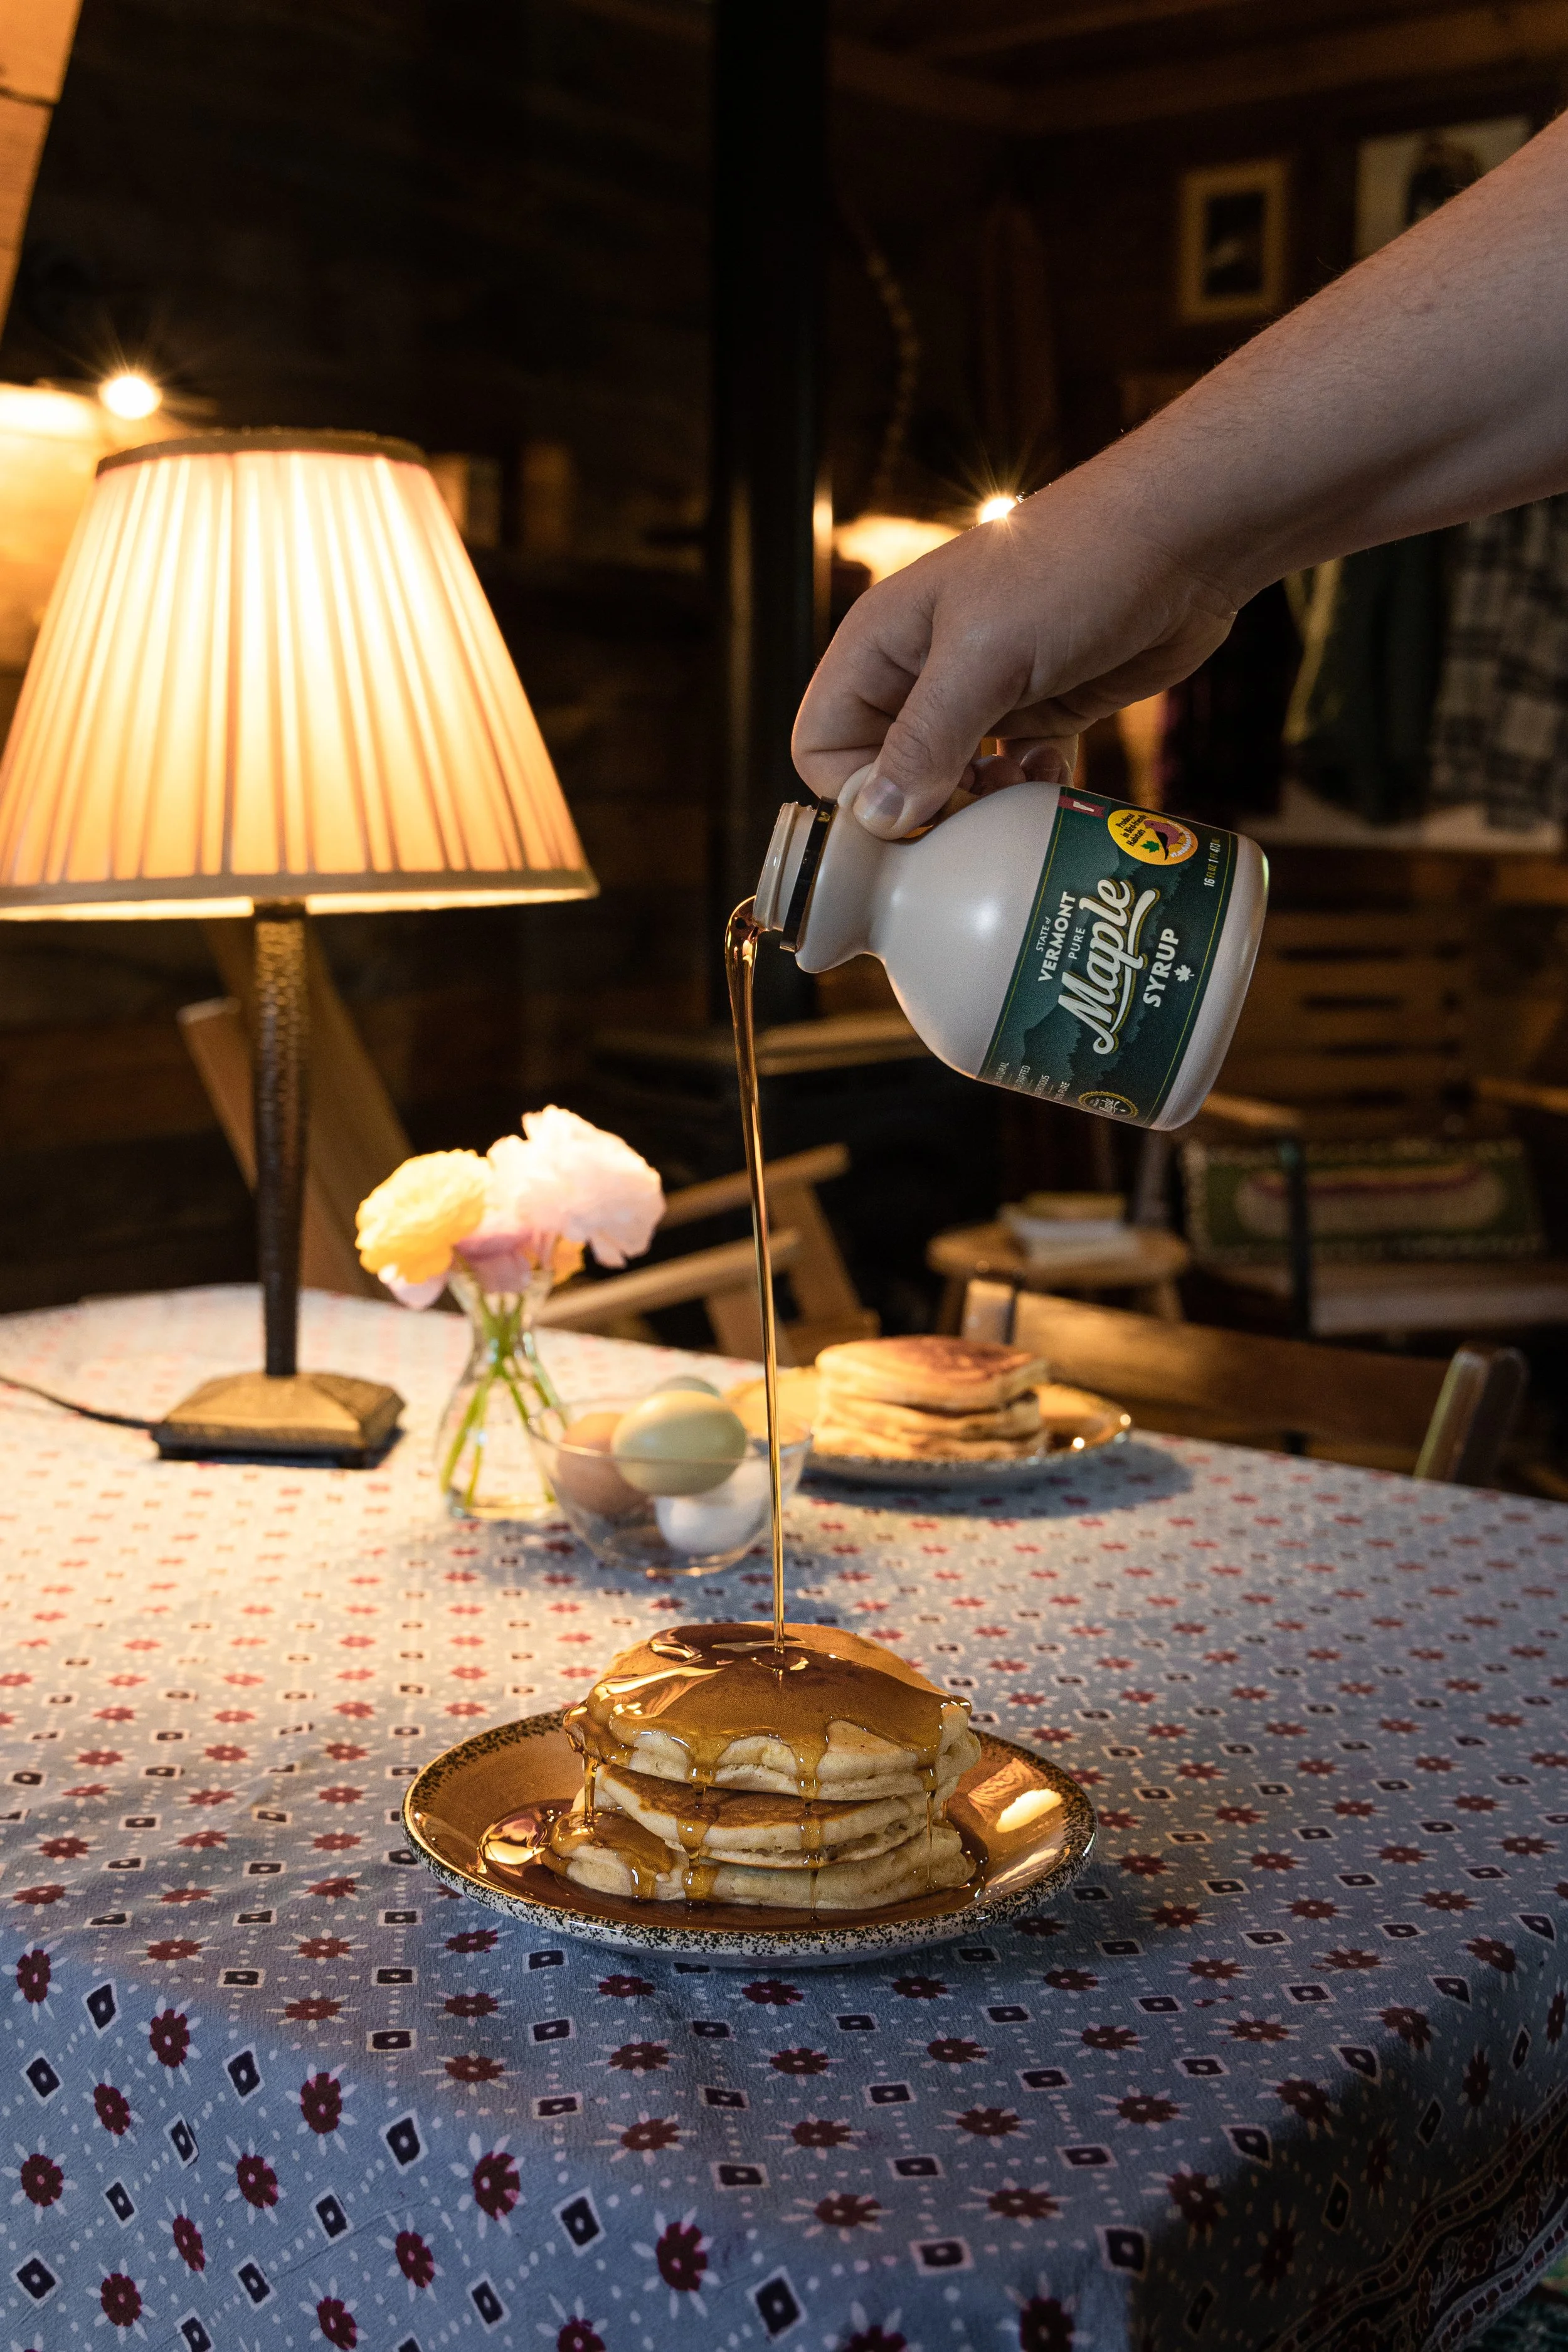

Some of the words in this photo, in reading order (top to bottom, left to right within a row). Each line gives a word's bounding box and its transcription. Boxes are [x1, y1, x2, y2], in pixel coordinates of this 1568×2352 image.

[1115, 813, 1135, 828] Produced
[1126, 829, 1146, 847] Habitats
[1209, 842, 1221, 853] 473
[1204, 878, 1216, 887] 16
[1036, 924, 1050, 952] STATE
[1045, 916, 1051, 924] of
[1037, 891, 1076, 982] VERMONT
[1068, 927, 1086, 960] PURE
[1058, 879, 1158, 1055] Maple
[1143, 928, 1179, 1008] SYRUP
[993, 1062, 1009, 1081] NATURAL
[1057, 1081, 1070, 1094] PURE
